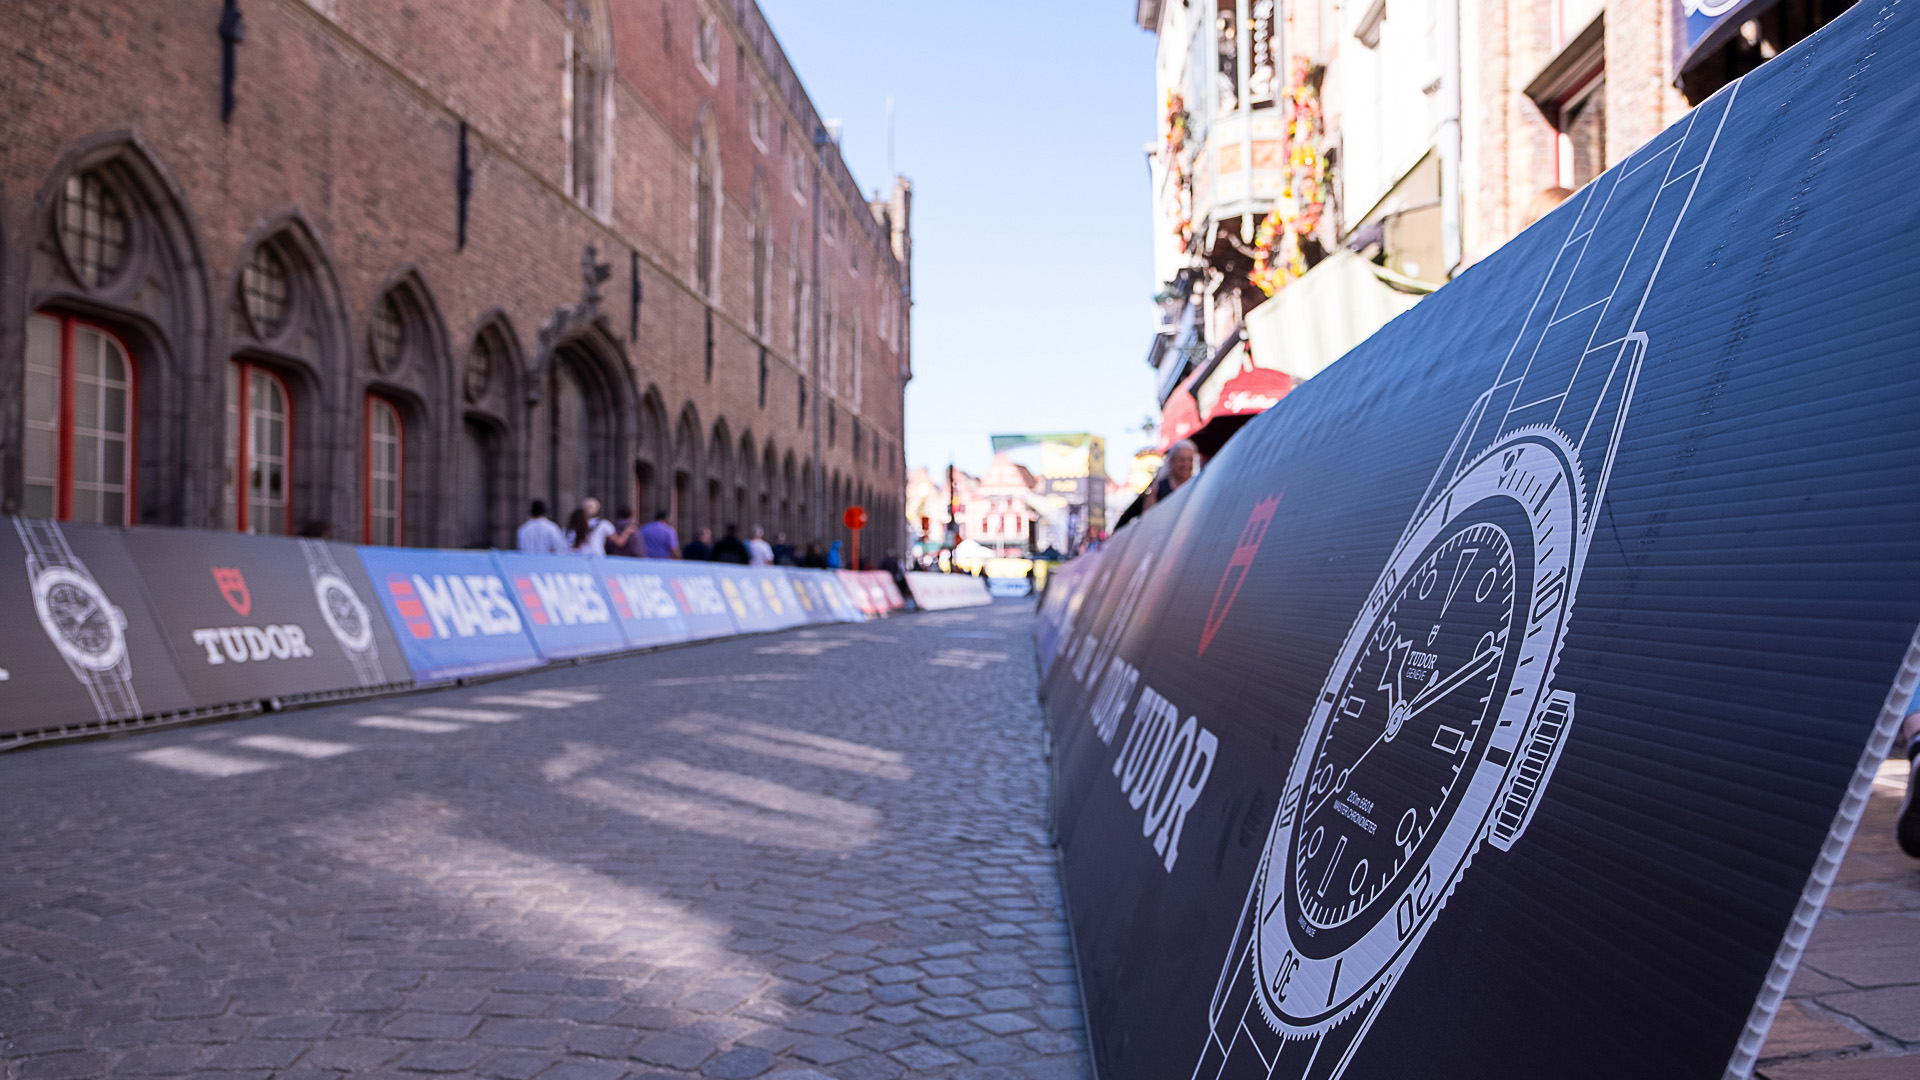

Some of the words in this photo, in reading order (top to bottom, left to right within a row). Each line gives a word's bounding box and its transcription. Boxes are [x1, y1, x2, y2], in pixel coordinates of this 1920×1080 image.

[412, 573, 522, 639] MAES
[529, 573, 610, 626] MAES
[1372, 568, 1396, 617] 50
[1532, 566, 1566, 624] 10
[192, 624, 314, 665] TUDOR
[1407, 651, 1438, 669] TUDOR
[1112, 685, 1219, 873] TUDOR
[1397, 864, 1433, 941] 20
[1272, 949, 1300, 1003] 30
